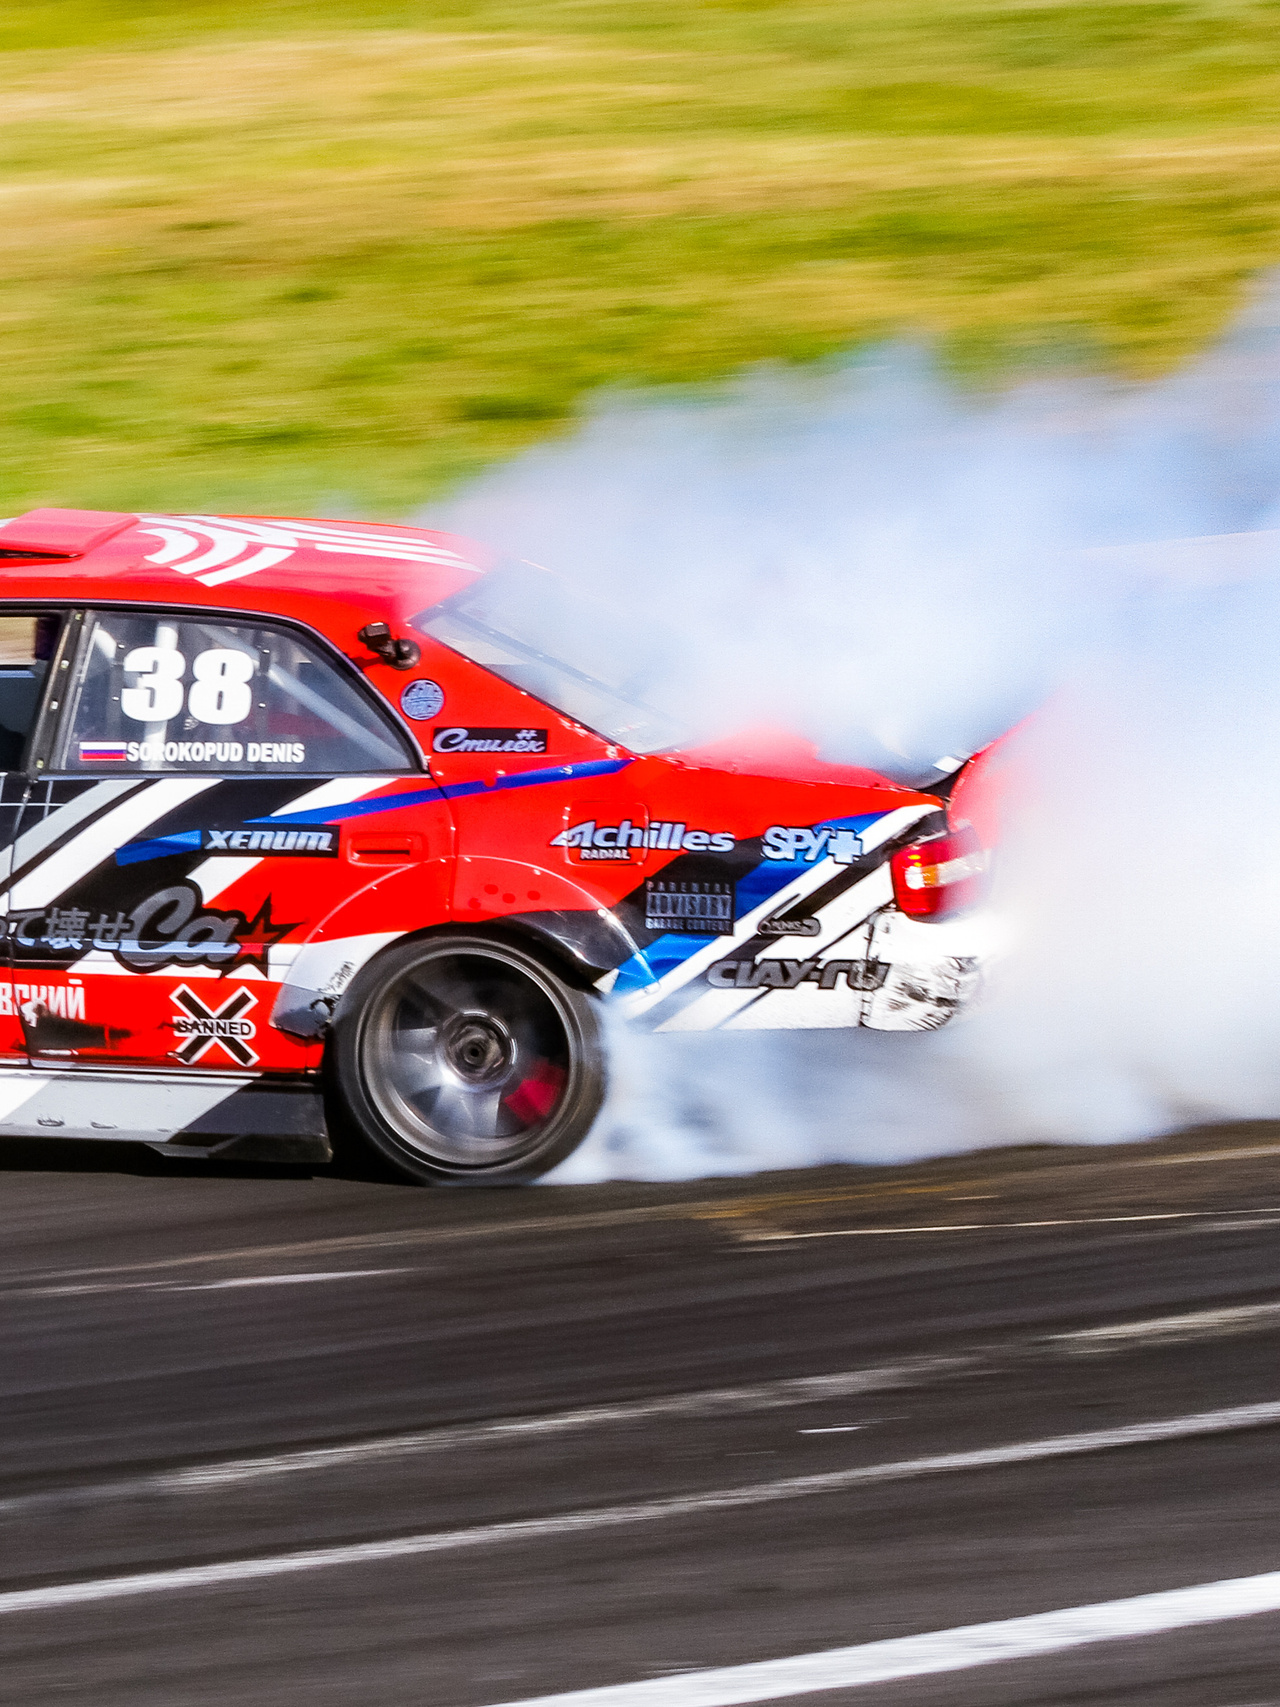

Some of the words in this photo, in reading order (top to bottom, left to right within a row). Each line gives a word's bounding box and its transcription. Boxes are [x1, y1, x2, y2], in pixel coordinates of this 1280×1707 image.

[121, 646, 255, 725] 38
[126, 742, 243, 762] SOROKOPUD
[247, 743, 305, 763] DENIS
[549, 820, 736, 852] Achilles
[580, 849, 631, 861] RADIAL
[646, 881, 731, 894] PARENTAL
